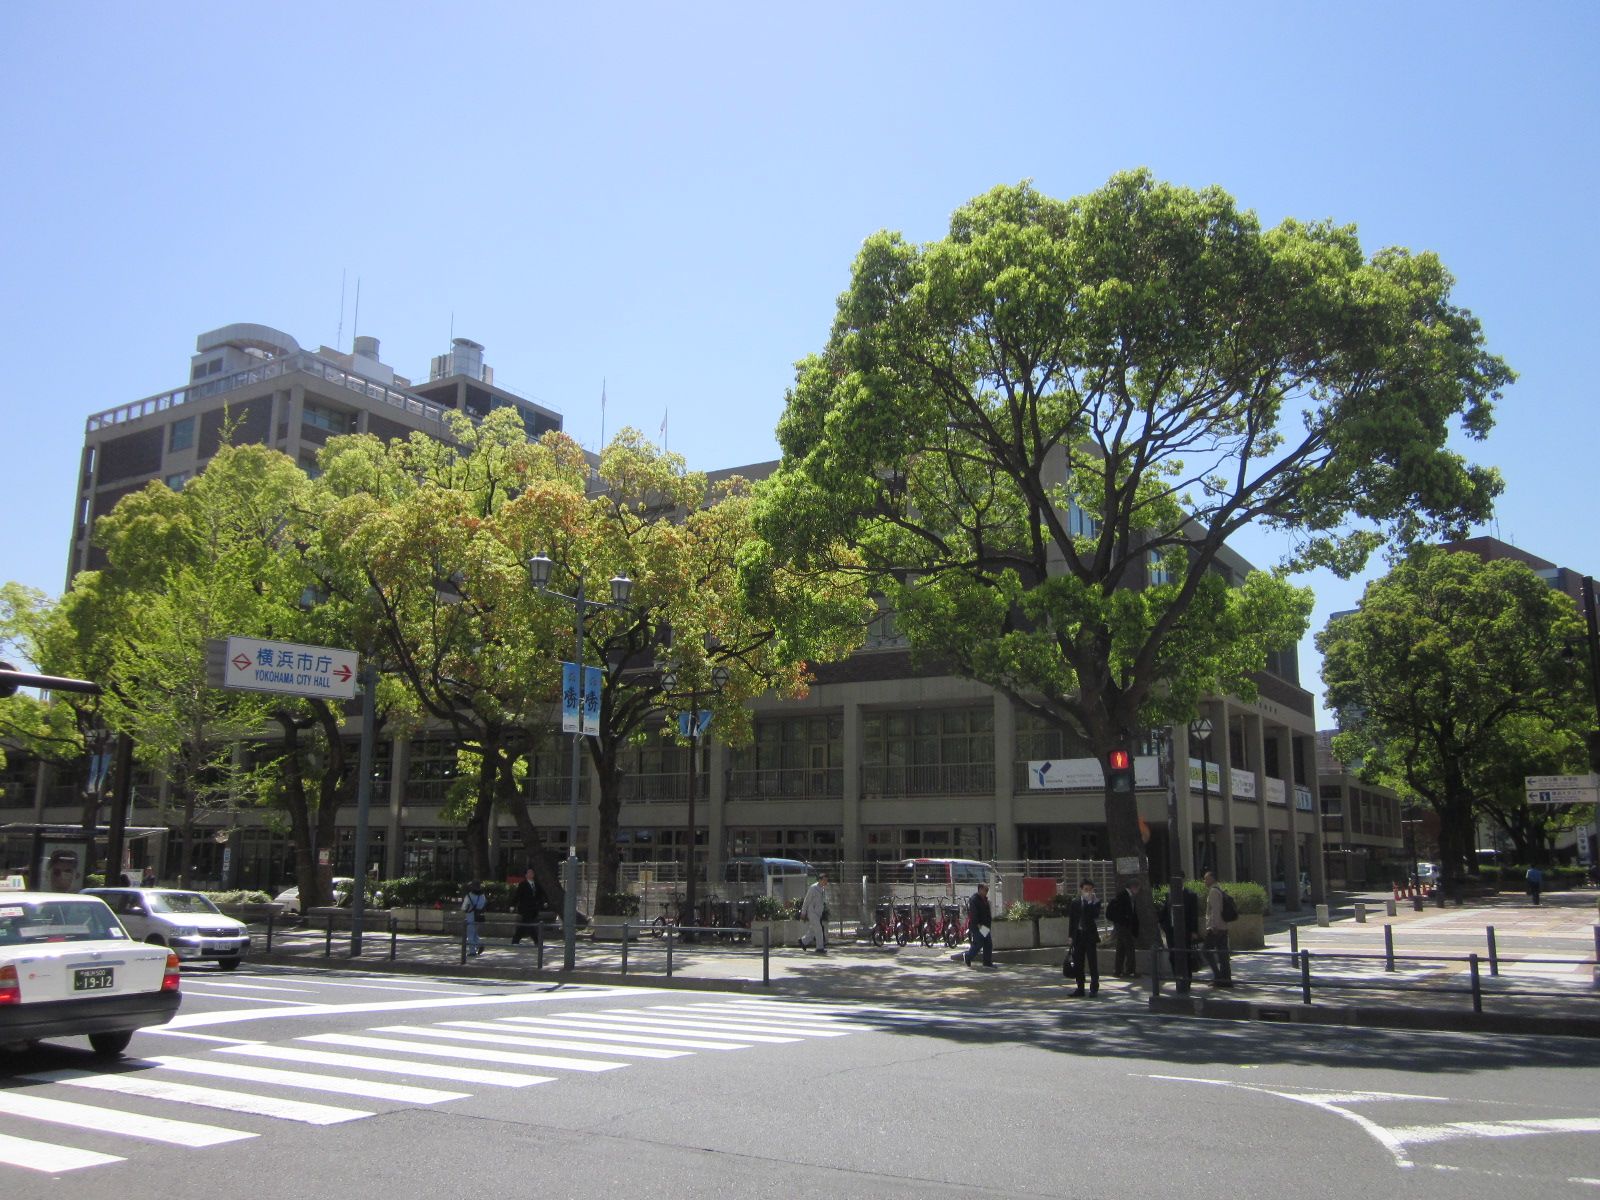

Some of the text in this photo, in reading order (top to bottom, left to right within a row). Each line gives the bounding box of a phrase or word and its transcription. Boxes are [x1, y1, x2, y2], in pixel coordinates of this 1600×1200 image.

[256, 648, 332, 673] 横浜市庁
[255, 670, 331, 688] YOKOHAMA CITY HALL
[84, 976, 112, 988] 19-12
